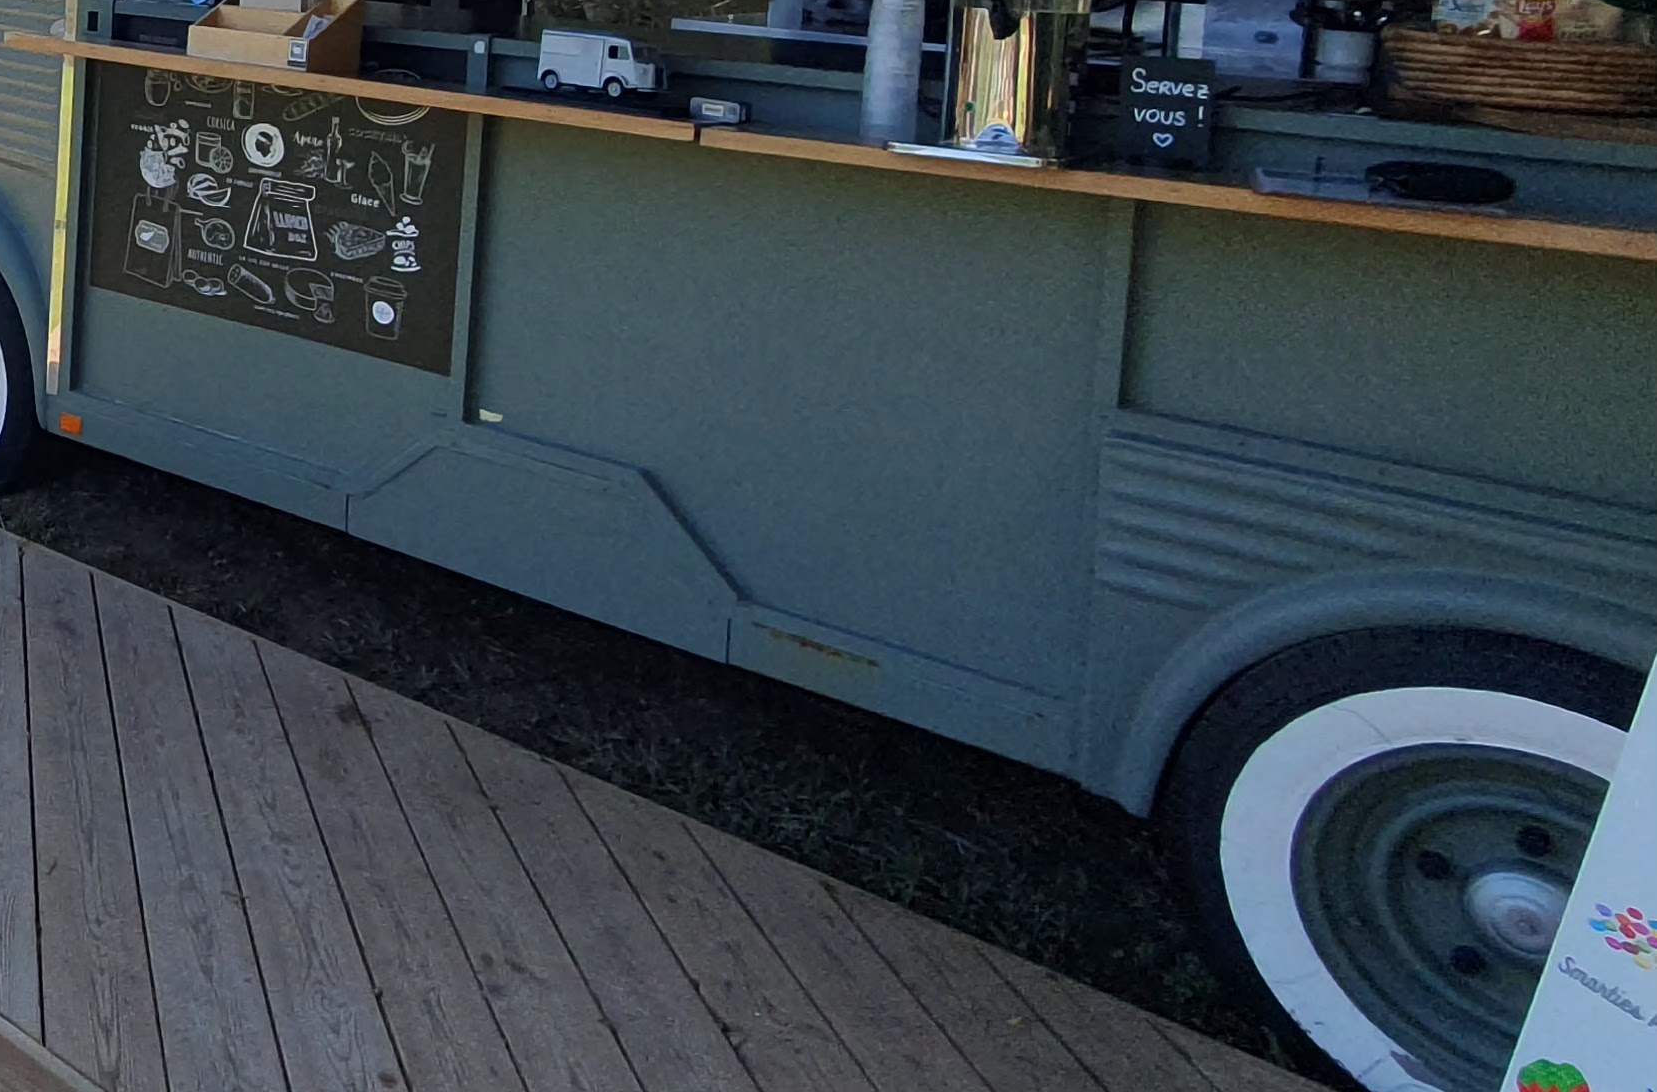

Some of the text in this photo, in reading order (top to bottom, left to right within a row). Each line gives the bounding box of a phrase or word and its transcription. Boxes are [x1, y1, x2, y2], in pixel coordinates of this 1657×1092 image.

[206, 115, 235, 131] CORSICA
[350, 193, 380, 208] Glace
[392, 239, 415, 251] CHIPS
[187, 248, 223, 266] AUTHENTIC
[1558, 956, 1646, 1021] Smarties
